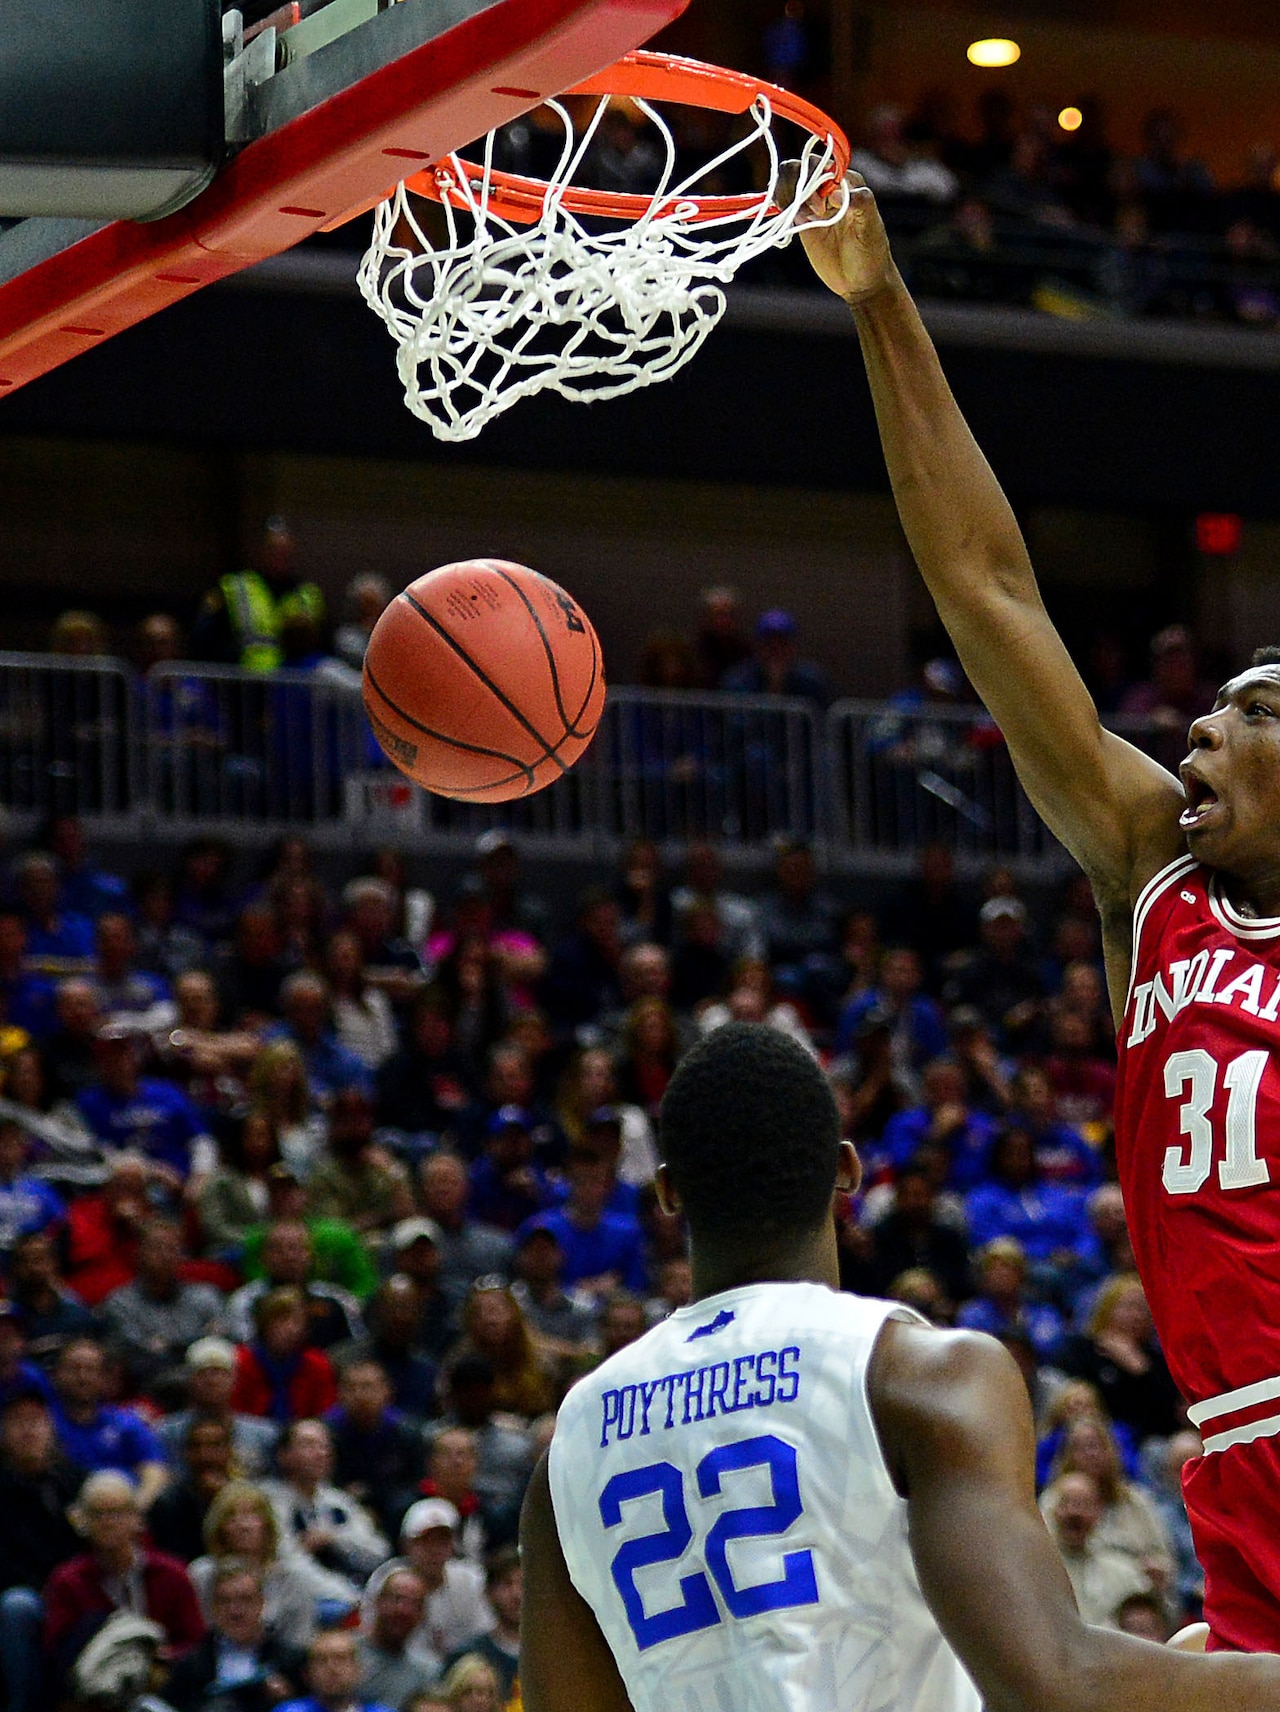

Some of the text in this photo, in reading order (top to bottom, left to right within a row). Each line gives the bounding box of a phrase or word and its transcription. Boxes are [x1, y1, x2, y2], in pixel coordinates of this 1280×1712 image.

[1161, 1048, 1270, 1195] 31
[599, 1346, 800, 1448] POYTHRESS
[598, 1434, 819, 1652] 22
